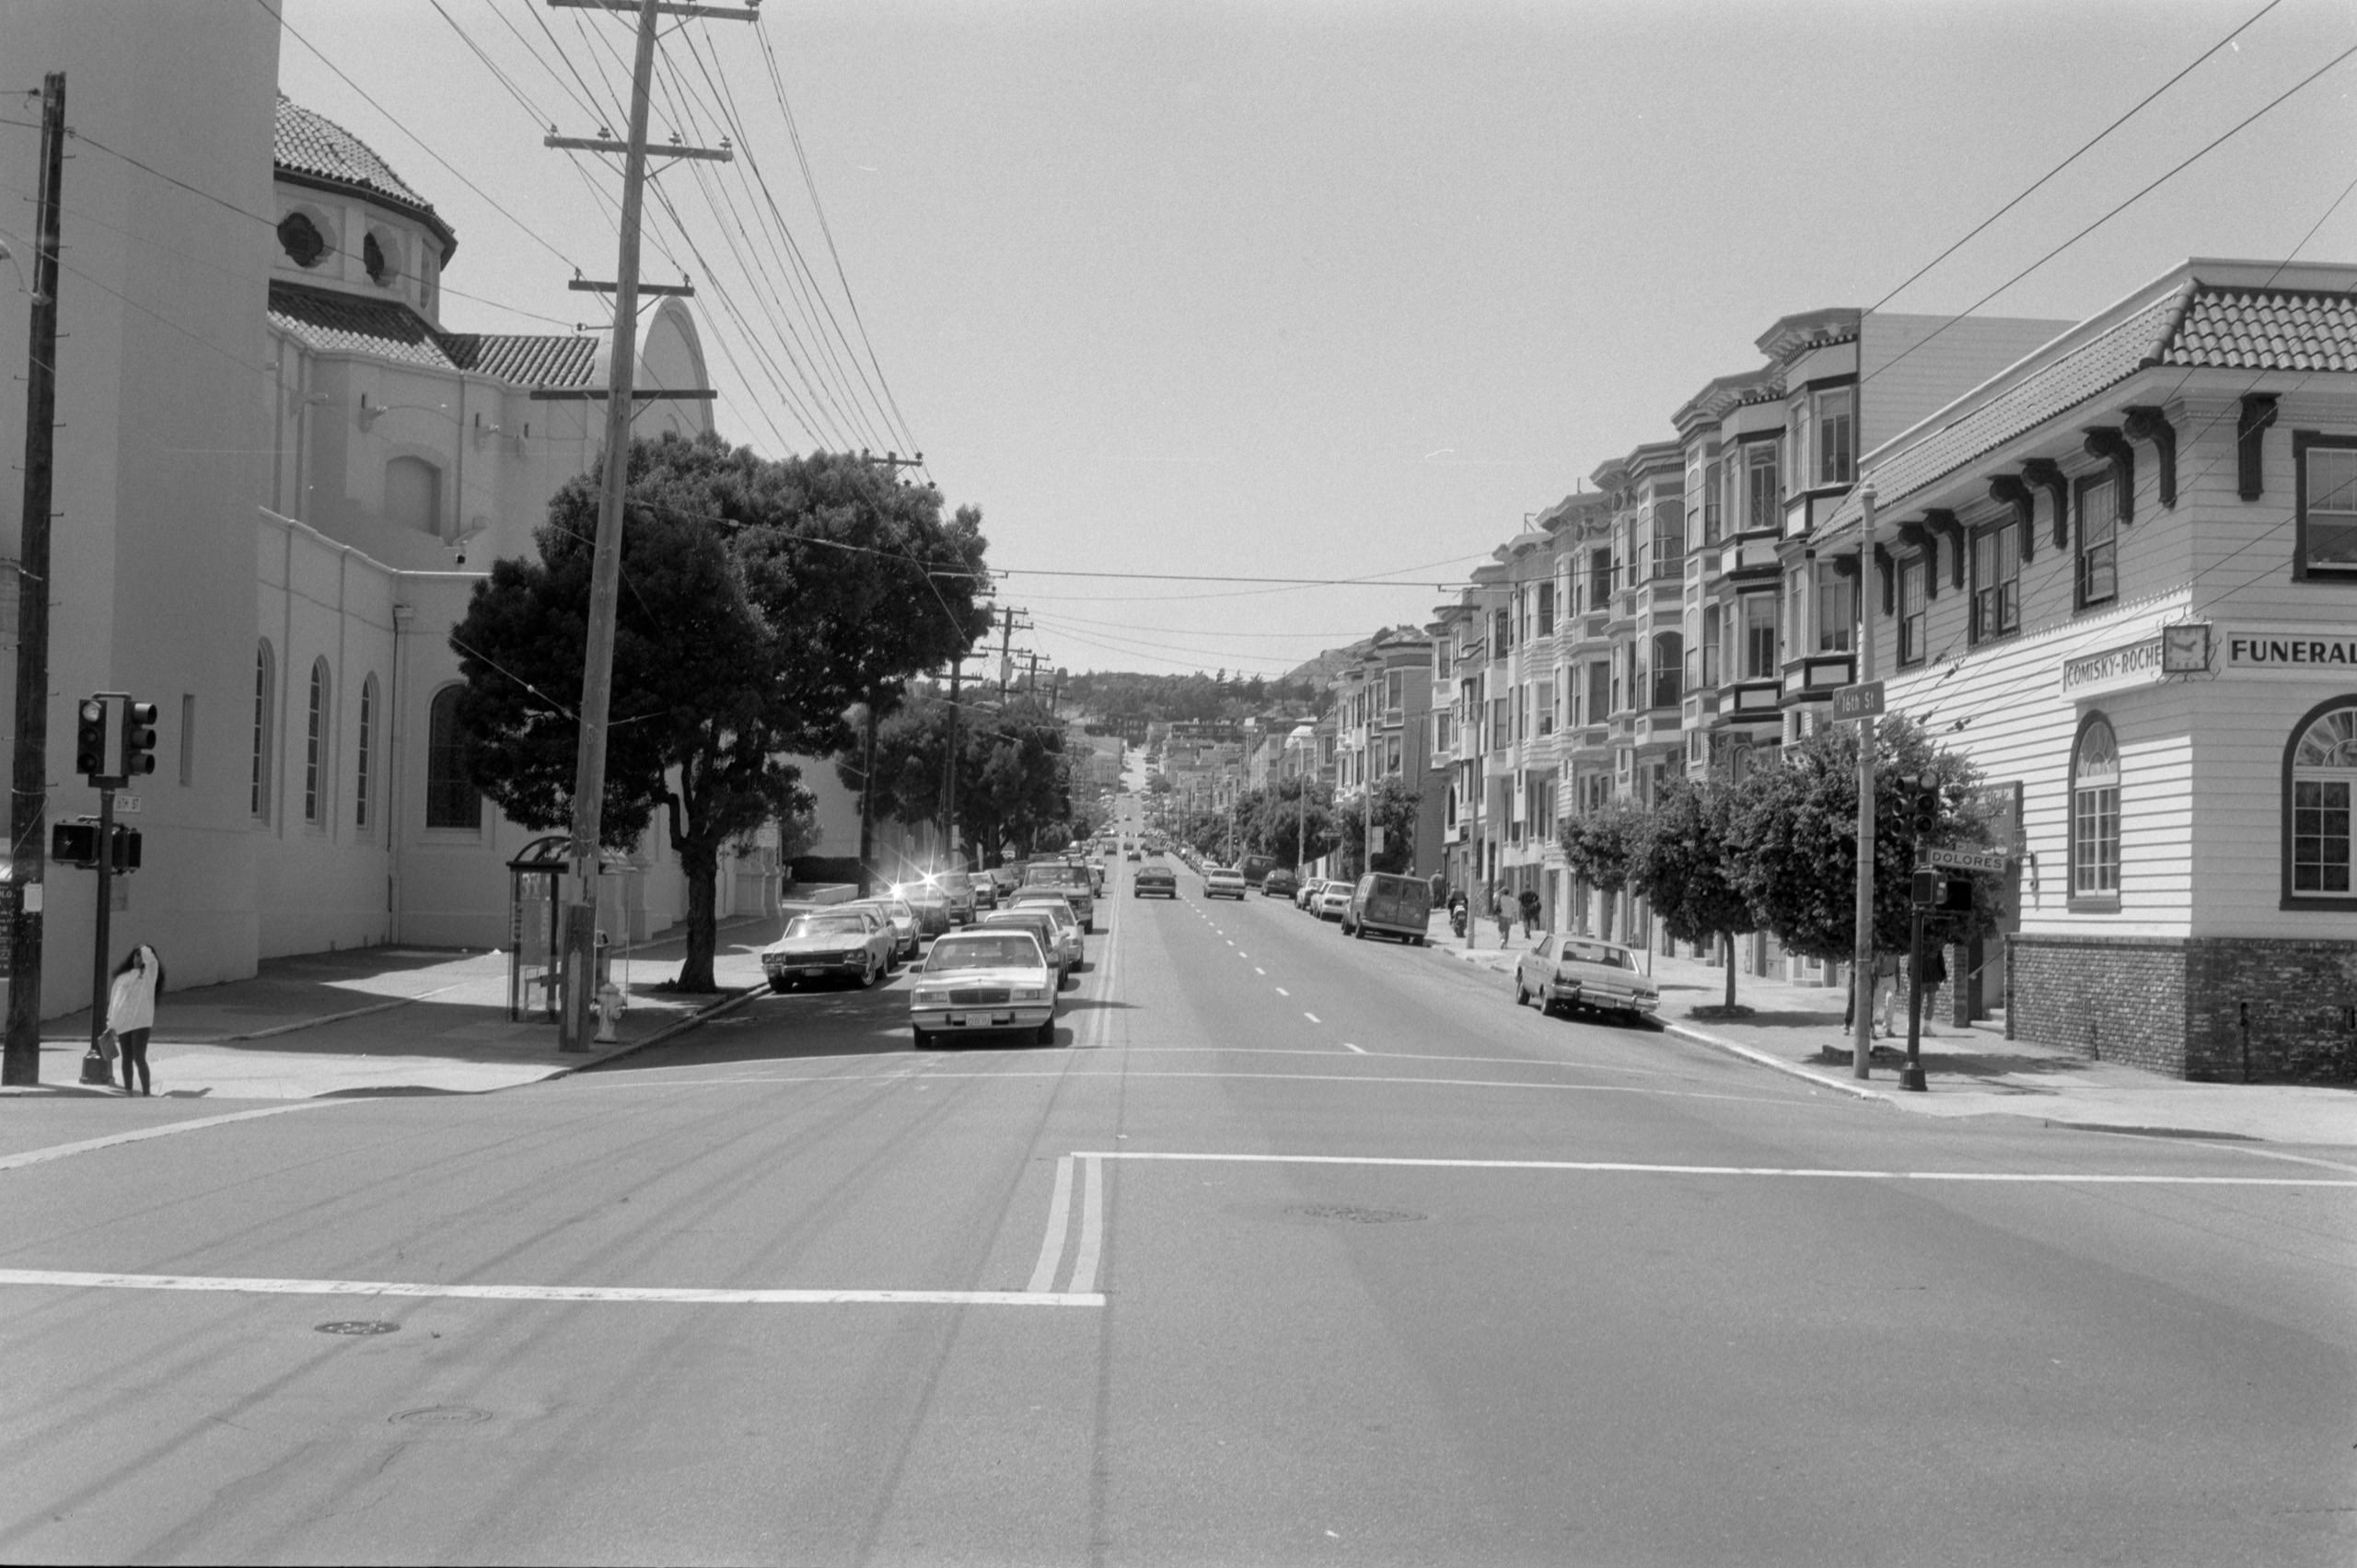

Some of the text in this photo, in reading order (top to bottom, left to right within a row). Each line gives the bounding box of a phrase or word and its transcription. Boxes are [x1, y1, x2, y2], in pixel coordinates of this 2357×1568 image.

[2232, 640, 2357, 664] FUNERAL
[2067, 645, 2162, 687] COMISKY-ROCHE
[1842, 693, 1860, 714] 16th
[1864, 691, 1875, 710] St
[1933, 852, 2003, 868] DOLORES
